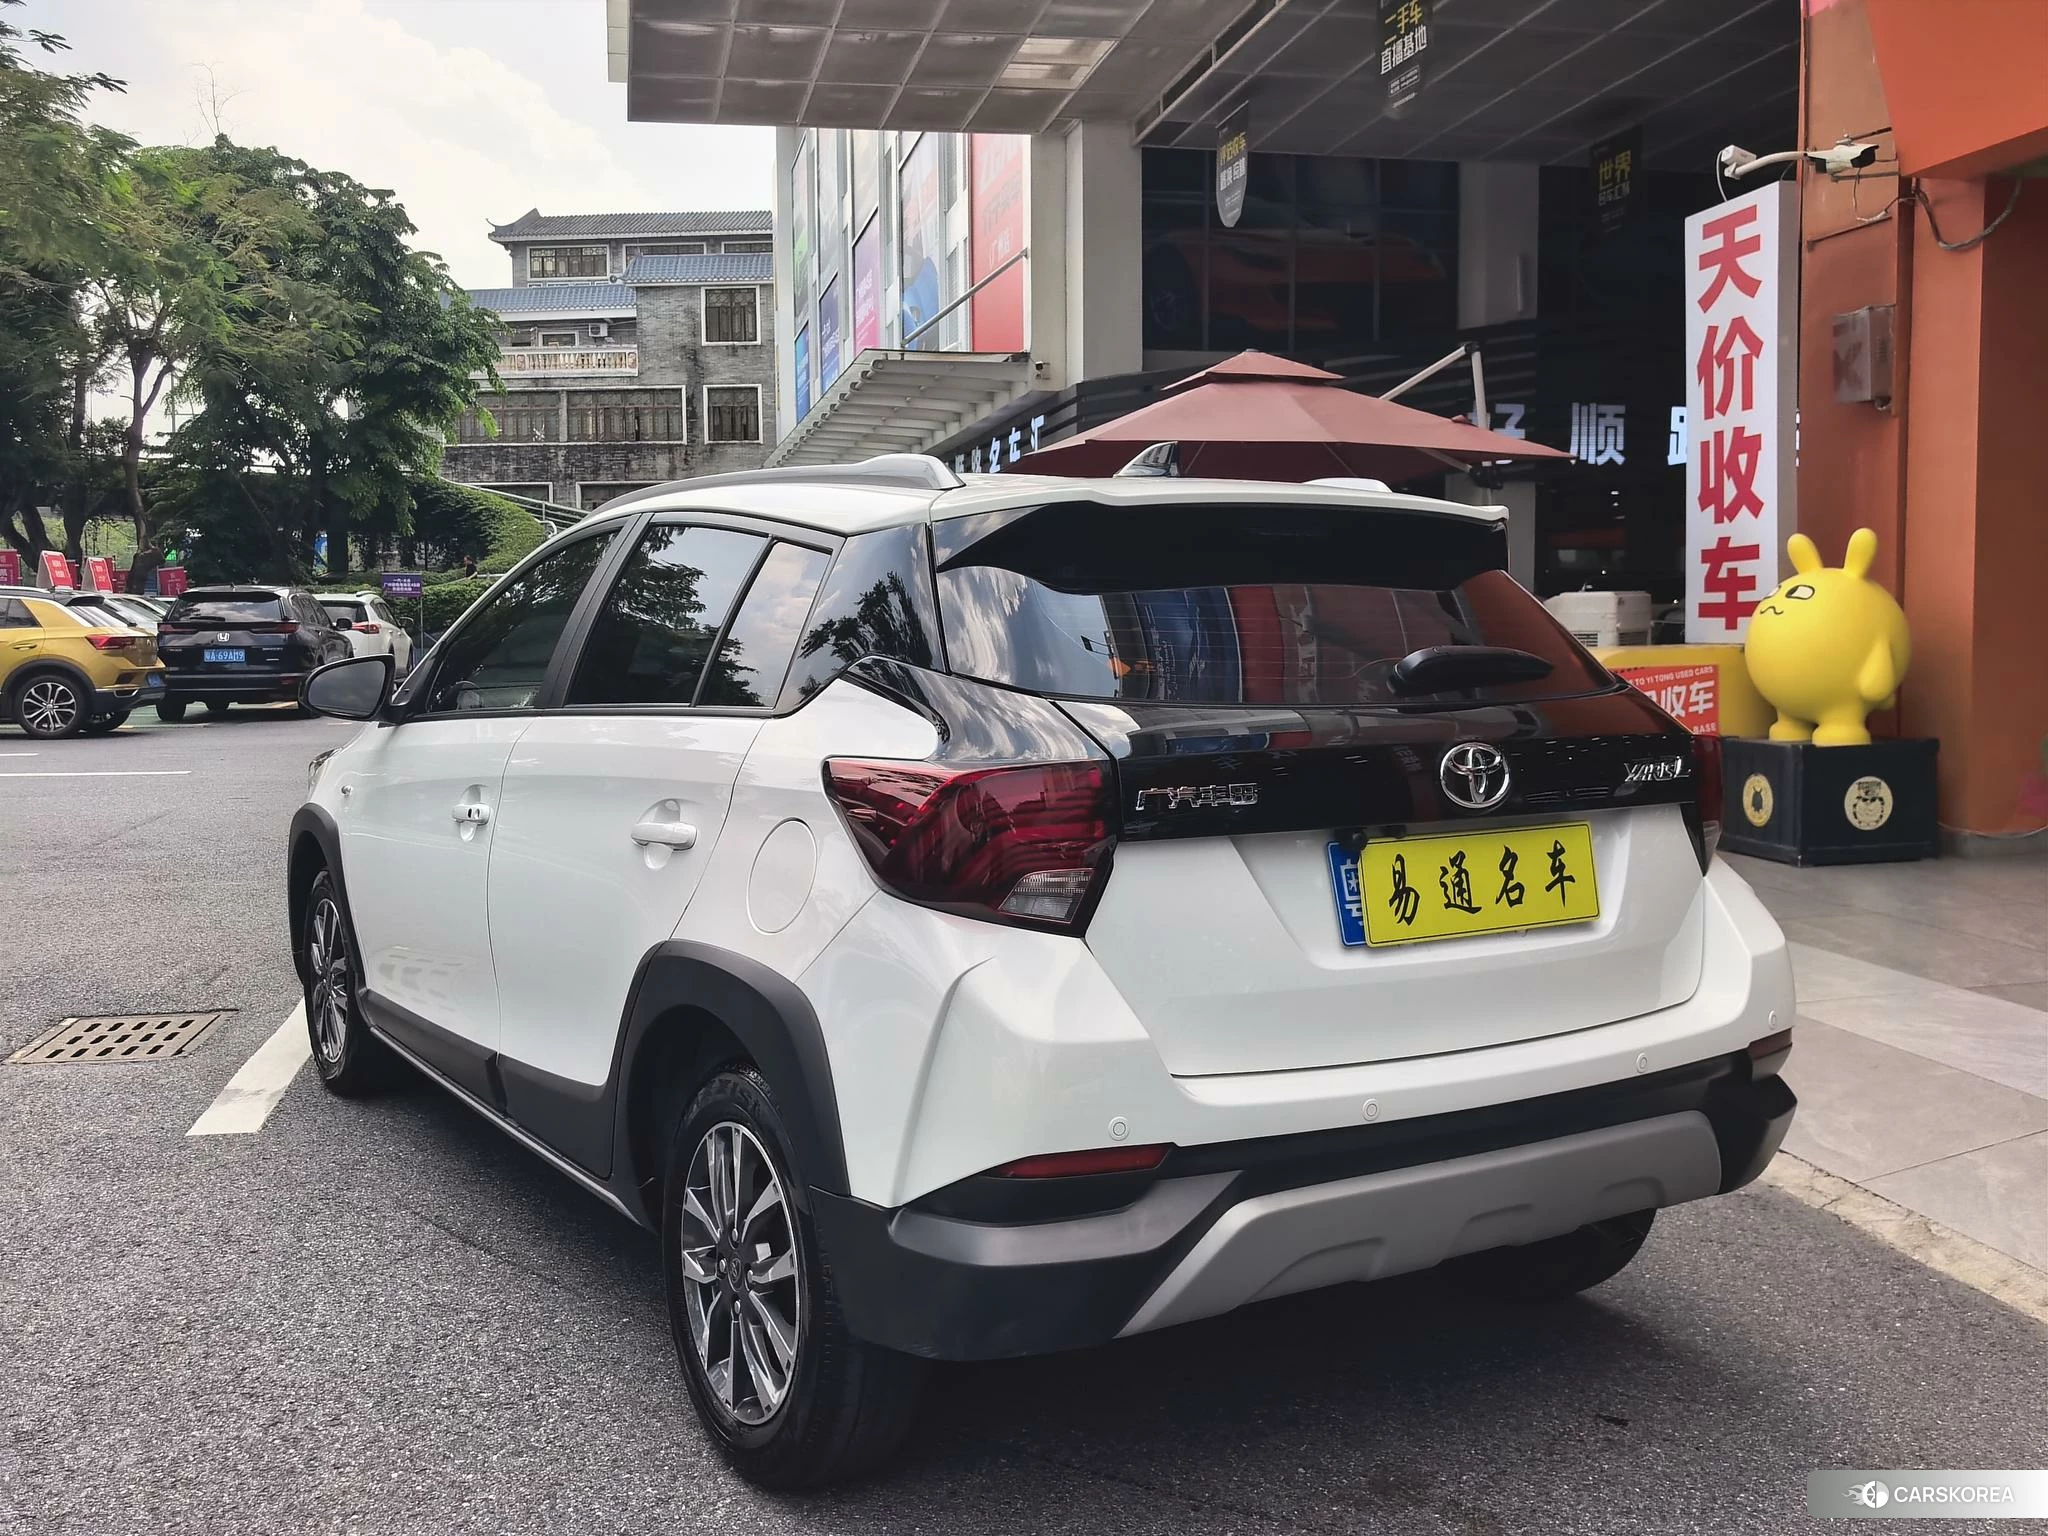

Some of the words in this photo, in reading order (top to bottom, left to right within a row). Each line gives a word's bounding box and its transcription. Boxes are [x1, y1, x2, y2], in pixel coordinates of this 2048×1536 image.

[1384, 0, 1423, 45] 二手车
[1380, 24, 1427, 75] 直播基地
[1697, 204, 1764, 630] 天价收车
[1635, 678, 1645, 686] TO
[1675, 668, 1694, 679] USED
[1387, 838, 1579, 926] 易通名车
